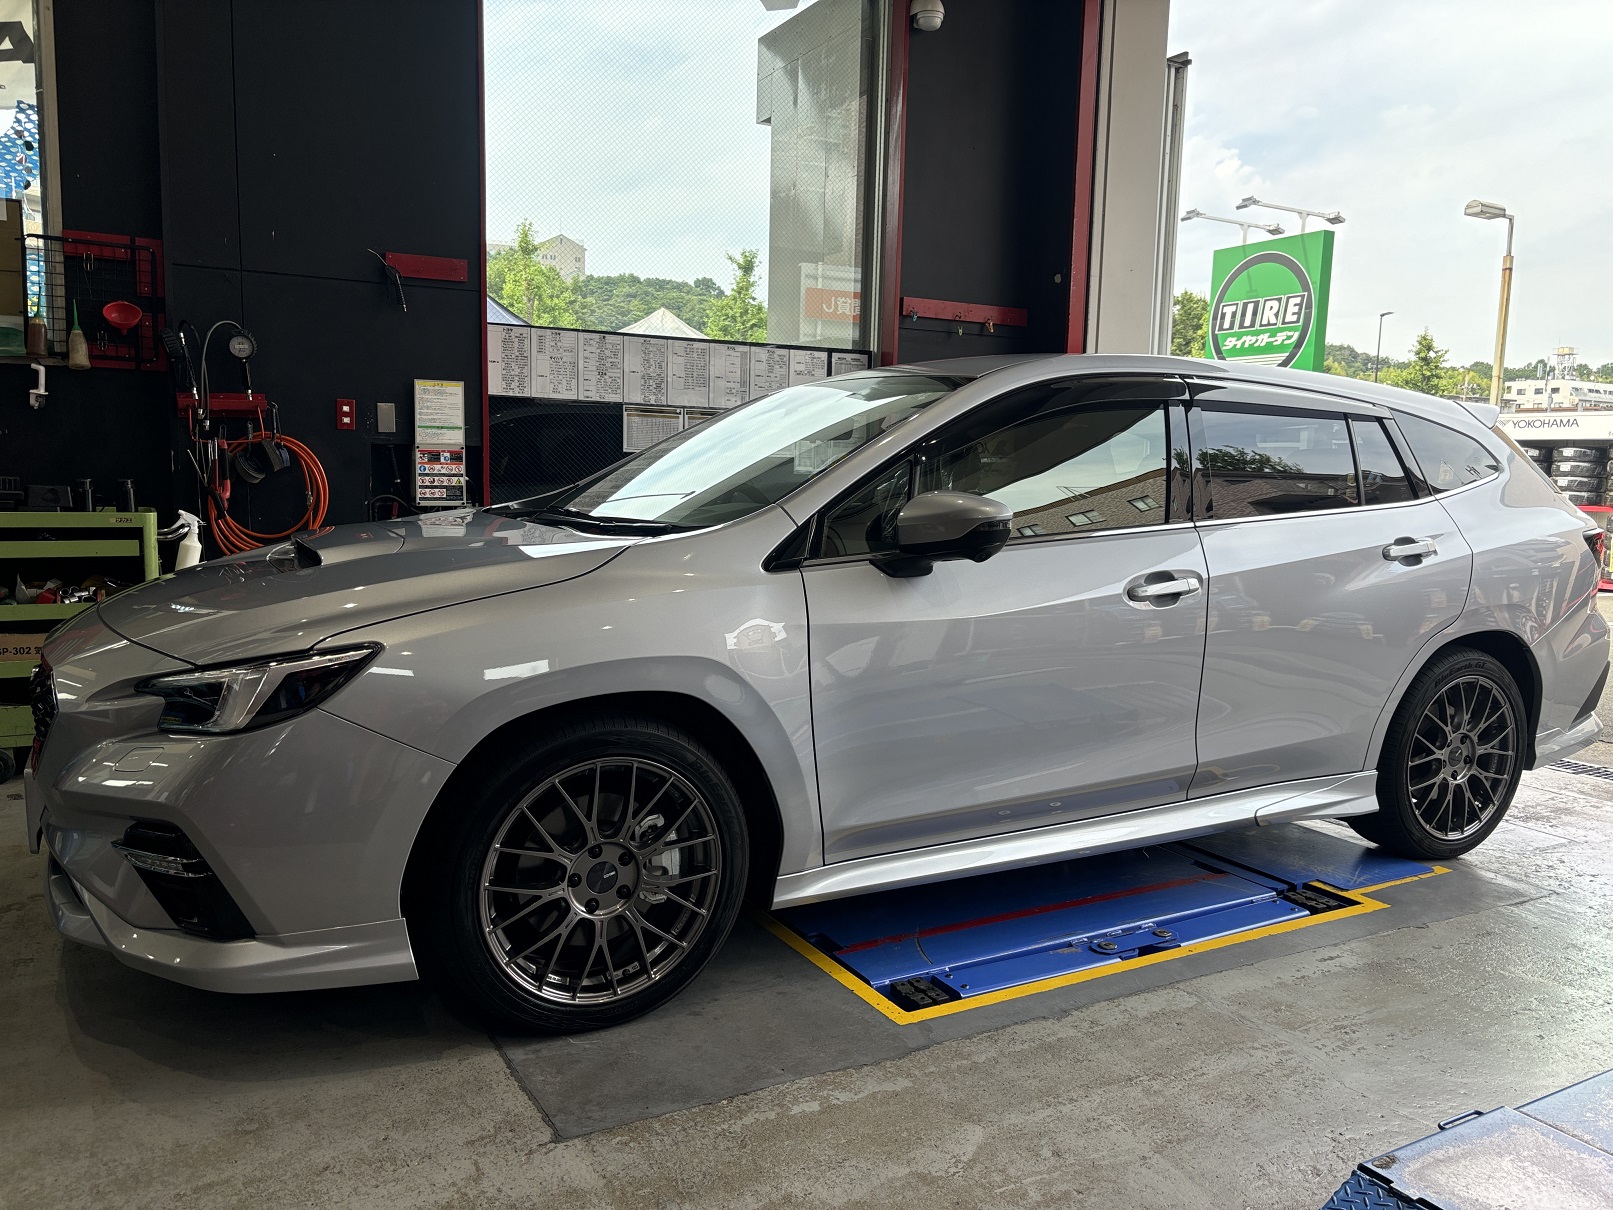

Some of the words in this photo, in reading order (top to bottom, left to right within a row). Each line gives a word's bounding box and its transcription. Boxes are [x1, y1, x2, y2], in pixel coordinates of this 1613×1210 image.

[1220, 296, 1303, 329] TIRE
[1222, 331, 1300, 350] タイヤガーデン
[1512, 418, 1580, 429] YOKOHAMA
